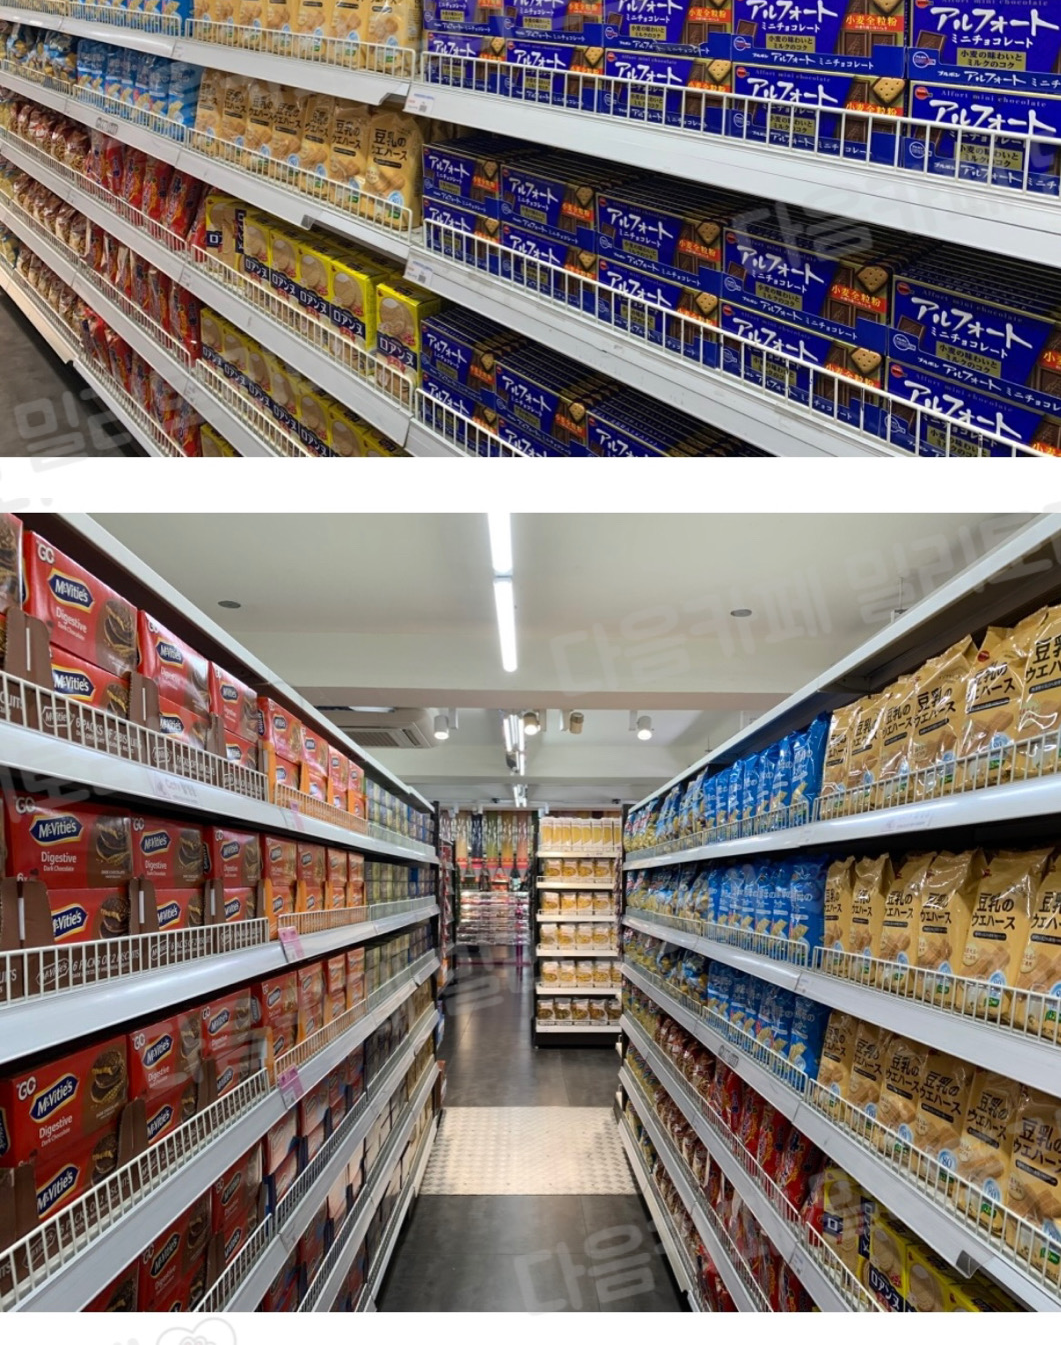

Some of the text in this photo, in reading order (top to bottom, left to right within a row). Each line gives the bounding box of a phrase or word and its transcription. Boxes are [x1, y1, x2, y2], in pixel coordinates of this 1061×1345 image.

[746, 0, 838, 23] アルフォート
[846, 16, 897, 27] 小麦全粒粉
[930, 6, 1060, 36] アルフォート
[762, 22, 821, 34] ミニチョコレート
[951, 34, 1034, 49] ミニチョコレート
[771, 52, 874, 70] アルフォート ミニチョコレート
[961, 50, 1023, 62] 小麦の味わいと
[964, 70, 1026, 87] アルフォート
[337, 119, 360, 137] 豆乳の
[374, 128, 407, 148] 豆乳の
[509, 177, 559, 204] アルフォート
[607, 208, 674, 239] アルフォート
[737, 244, 824, 285] アルフォート
[272, 273, 295, 295] ロアンヌ
[752, 269, 808, 294] ミニチョコレート
[300, 290, 327, 314] ロアンヌ
[831, 284, 881, 308] 小麦全粒粉
[333, 309, 363, 336] ロアンヌ
[761, 301, 858, 340] アルフォート ミニチョコレート
[912, 297, 1033, 349] アルフォート
[380, 337, 414, 366] ロアンヌ
[931, 326, 1008, 359] ミニチョコレート
[940, 343, 998, 370] 小麦の味わいと
[943, 363, 1001, 391] アルフォート
[55, 577, 89, 603] McVitie's
[56, 606, 87, 633] Digestive
[917, 687, 952, 712] 豆乳の
[38, 821, 76, 839] McVitie's
[41, 851, 77, 864] Digestive
[145, 860, 167, 870] Digestive
[978, 891, 1014, 912] 豆乳の
[972, 915, 1015, 930] ウエハース
[890, 1053, 919, 1077] 豆乳の
[18, 1075, 36, 1101] GO
[925, 1071, 960, 1097] 豆乳の
[37, 1081, 74, 1117] McVitie's
[919, 1086, 962, 1116] ウエハース
[39, 1114, 73, 1138] Digestive
[967, 1110, 1007, 1140] ウエハース
[871, 1270, 900, 1310] ロアンヌ
